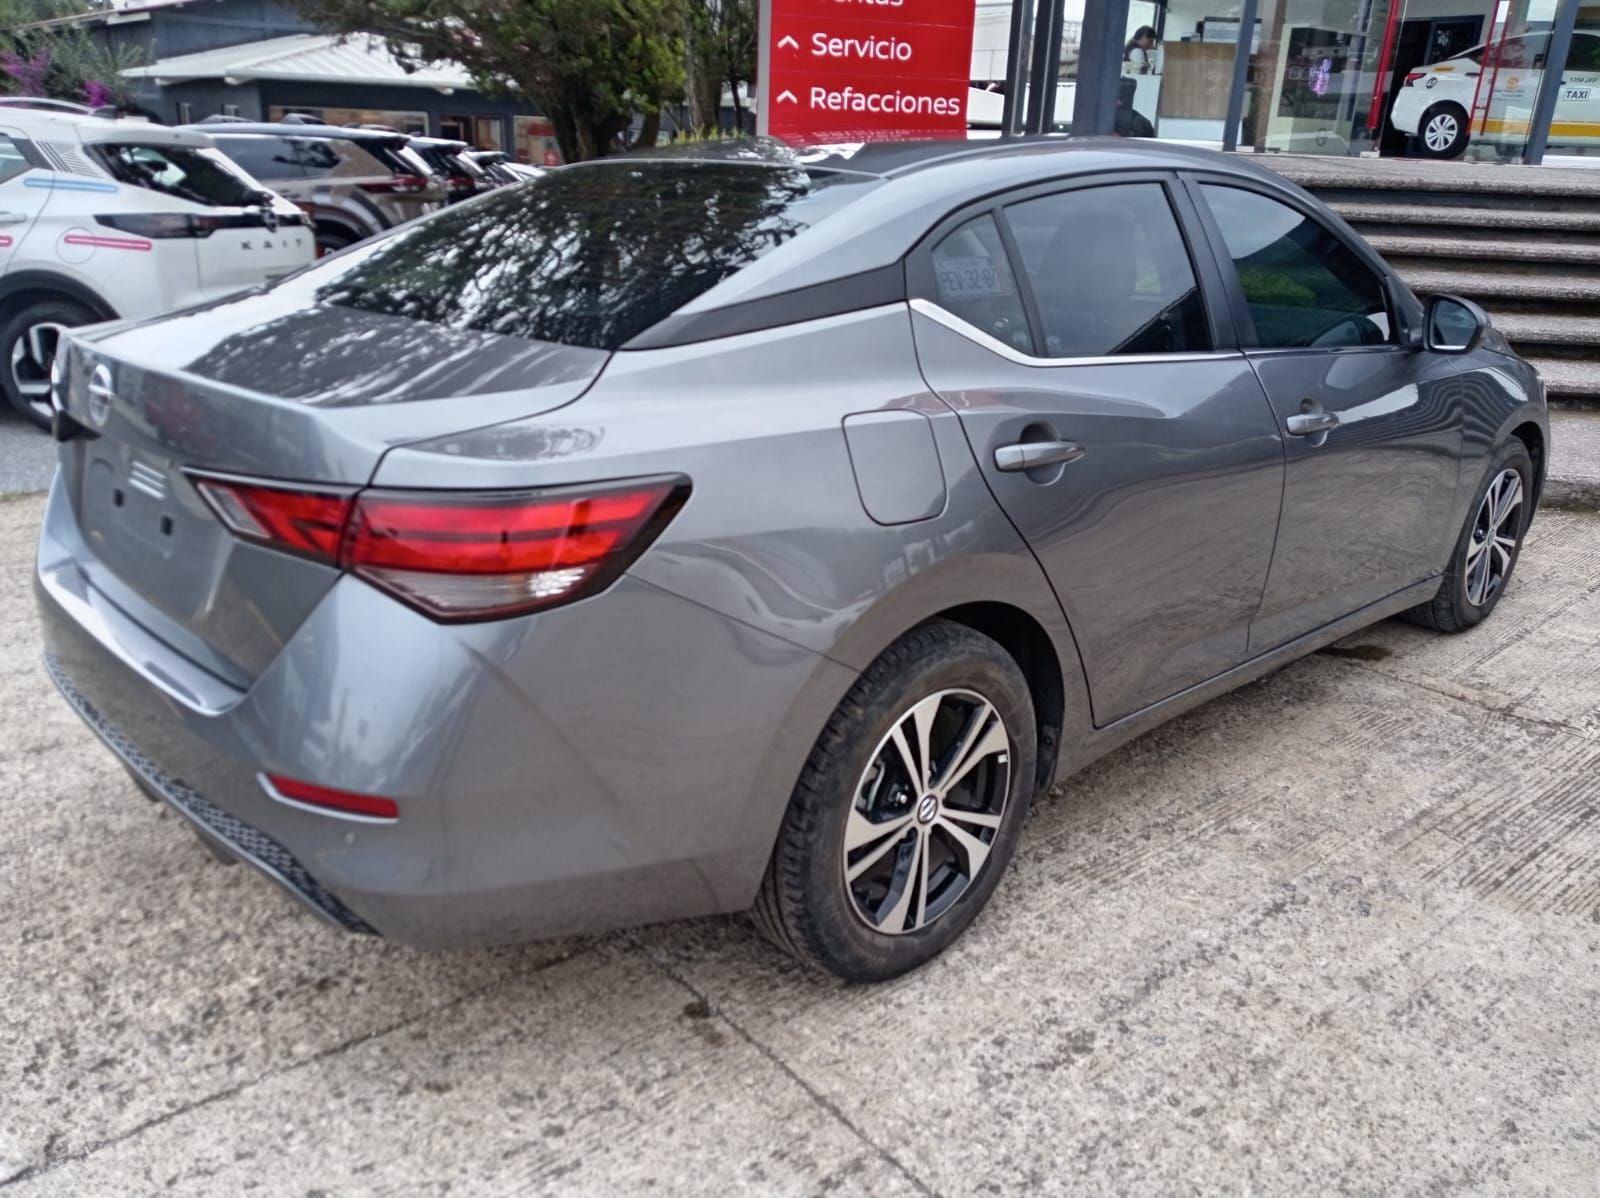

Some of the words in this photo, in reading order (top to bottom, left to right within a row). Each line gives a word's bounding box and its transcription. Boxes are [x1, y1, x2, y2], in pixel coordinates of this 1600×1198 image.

[811, 32, 912, 61] Servicio
[810, 87, 961, 115] Refacciones
[1566, 90, 1589, 99] TAXI
[240, 237, 302, 250] KAIT
